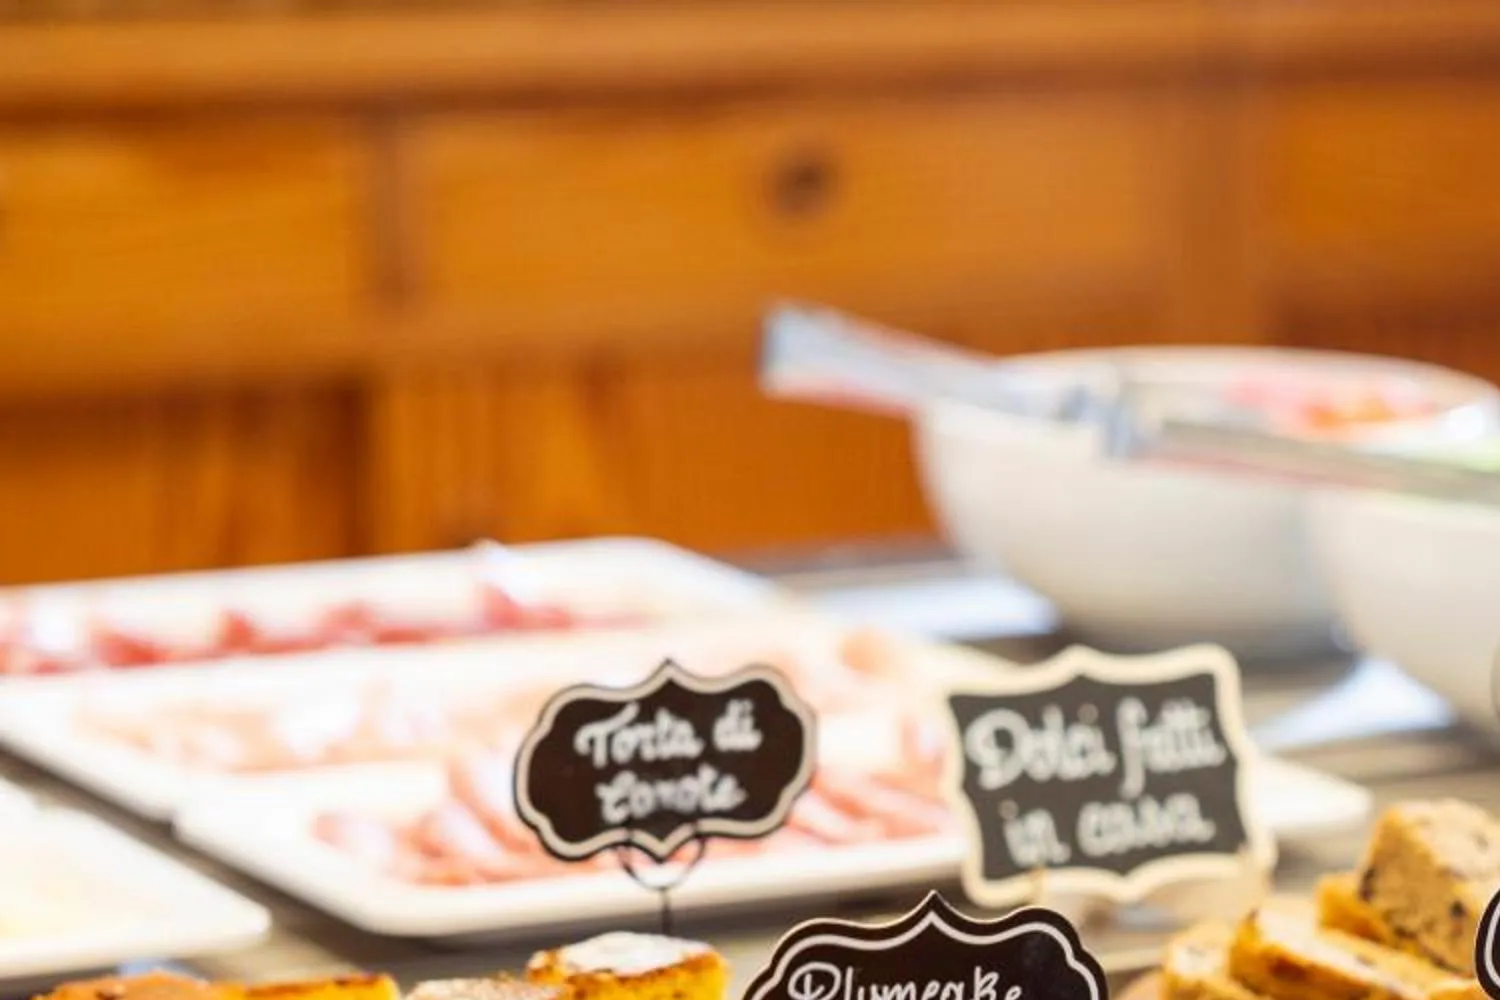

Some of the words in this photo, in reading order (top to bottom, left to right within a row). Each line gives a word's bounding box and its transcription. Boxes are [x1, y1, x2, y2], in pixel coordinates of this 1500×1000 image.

[573, 700, 704, 767] Torta
[712, 698, 763, 751] di
[1114, 696, 1227, 800] fatti
[998, 798, 1072, 867] in
